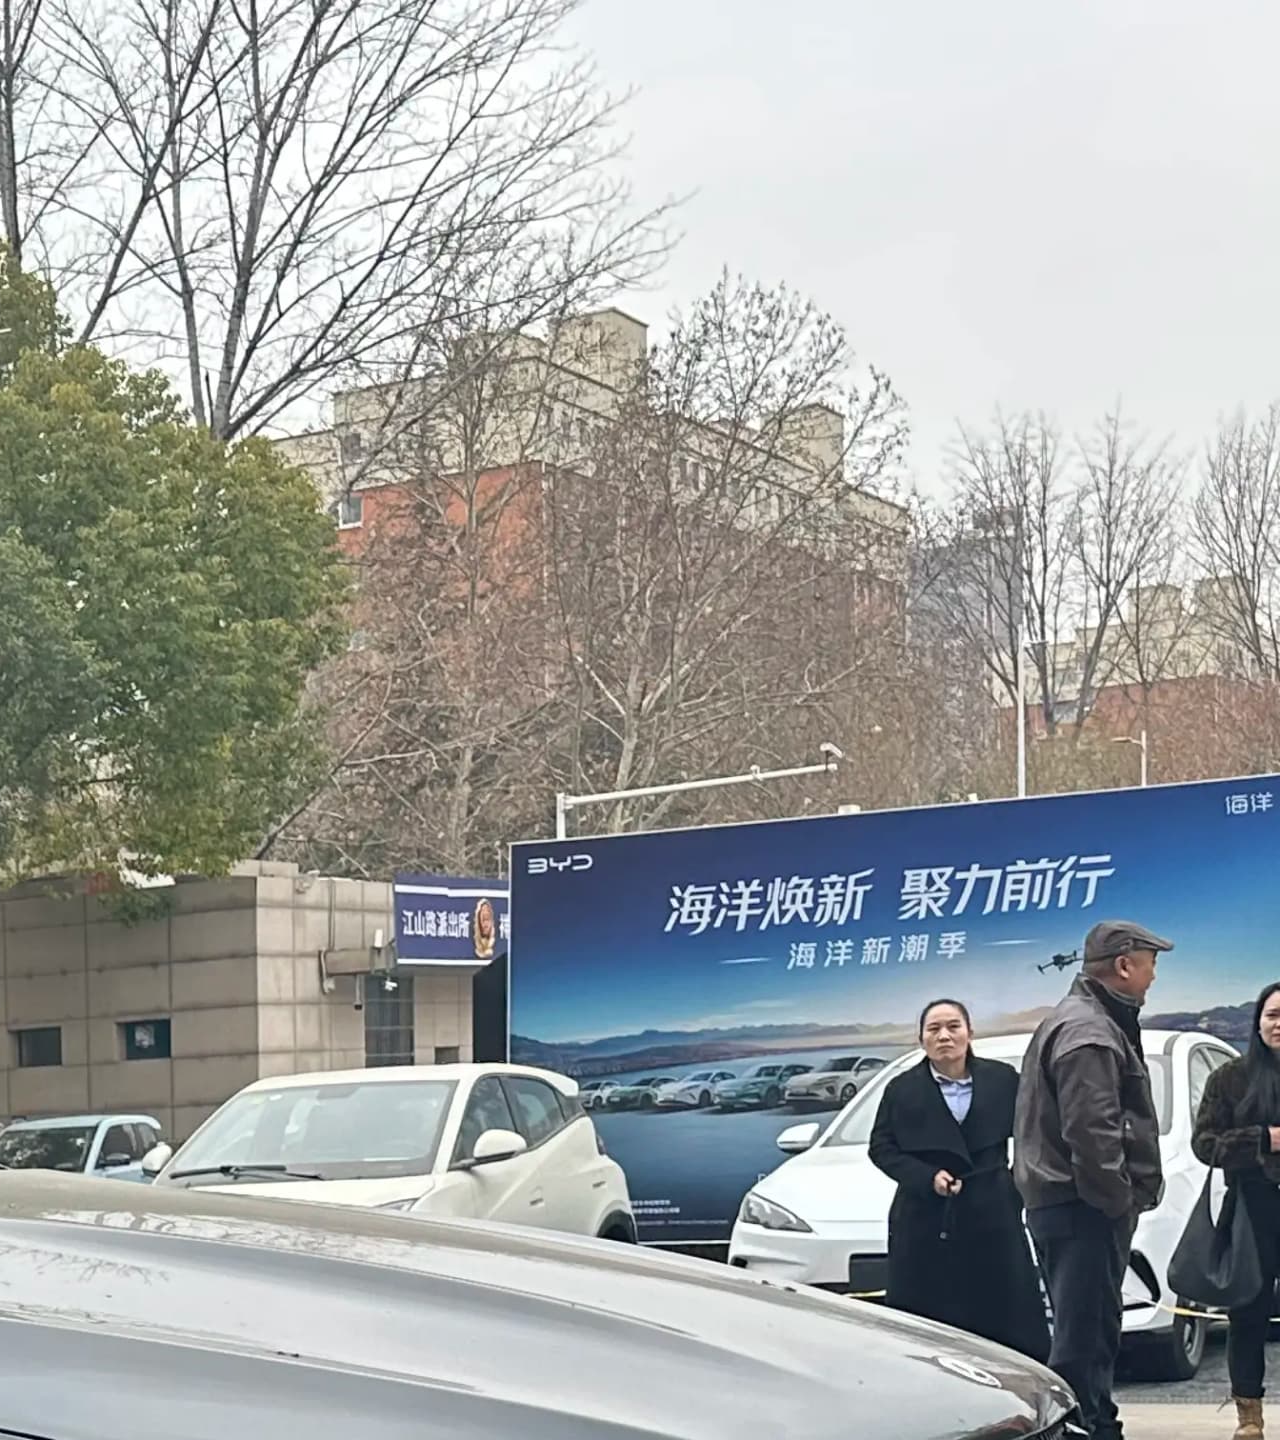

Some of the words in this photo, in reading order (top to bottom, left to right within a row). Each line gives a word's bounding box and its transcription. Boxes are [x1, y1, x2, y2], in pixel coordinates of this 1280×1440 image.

[1225, 792, 1273, 815] 海洋
[527, 854, 593, 874] BYD
[664, 867, 876, 935] 海洋焕新
[897, 855, 1116, 920] 聚力前行
[787, 930, 968, 970] 海洋新潮季
